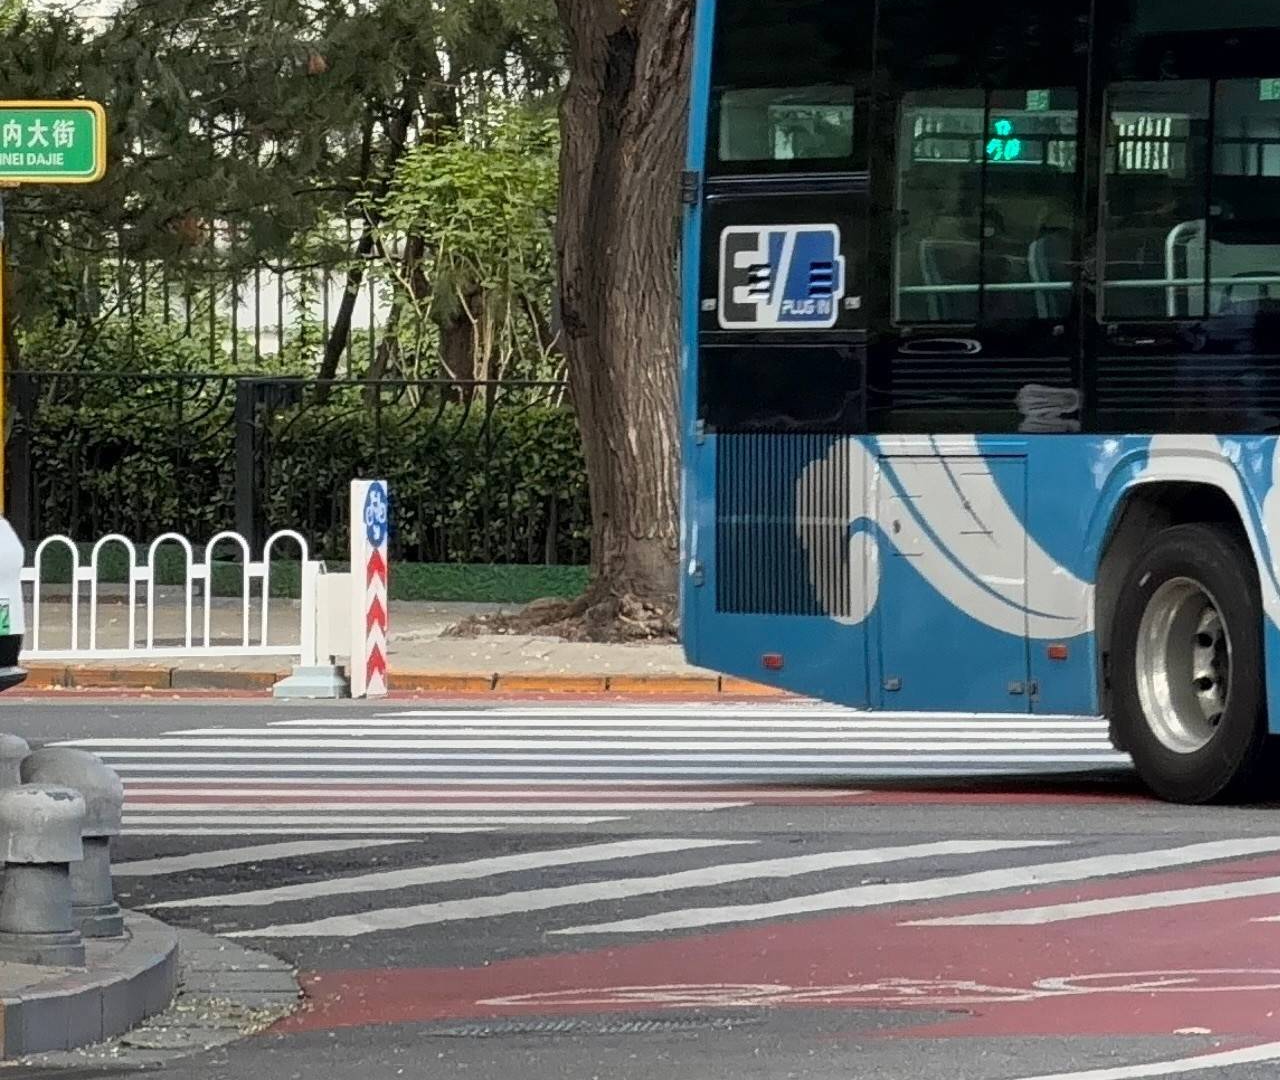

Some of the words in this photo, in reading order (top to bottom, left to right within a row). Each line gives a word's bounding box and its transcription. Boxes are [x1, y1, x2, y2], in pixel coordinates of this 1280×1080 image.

[2, 119, 75, 148] 内大街
[26, 153, 64, 166] DAJIE
